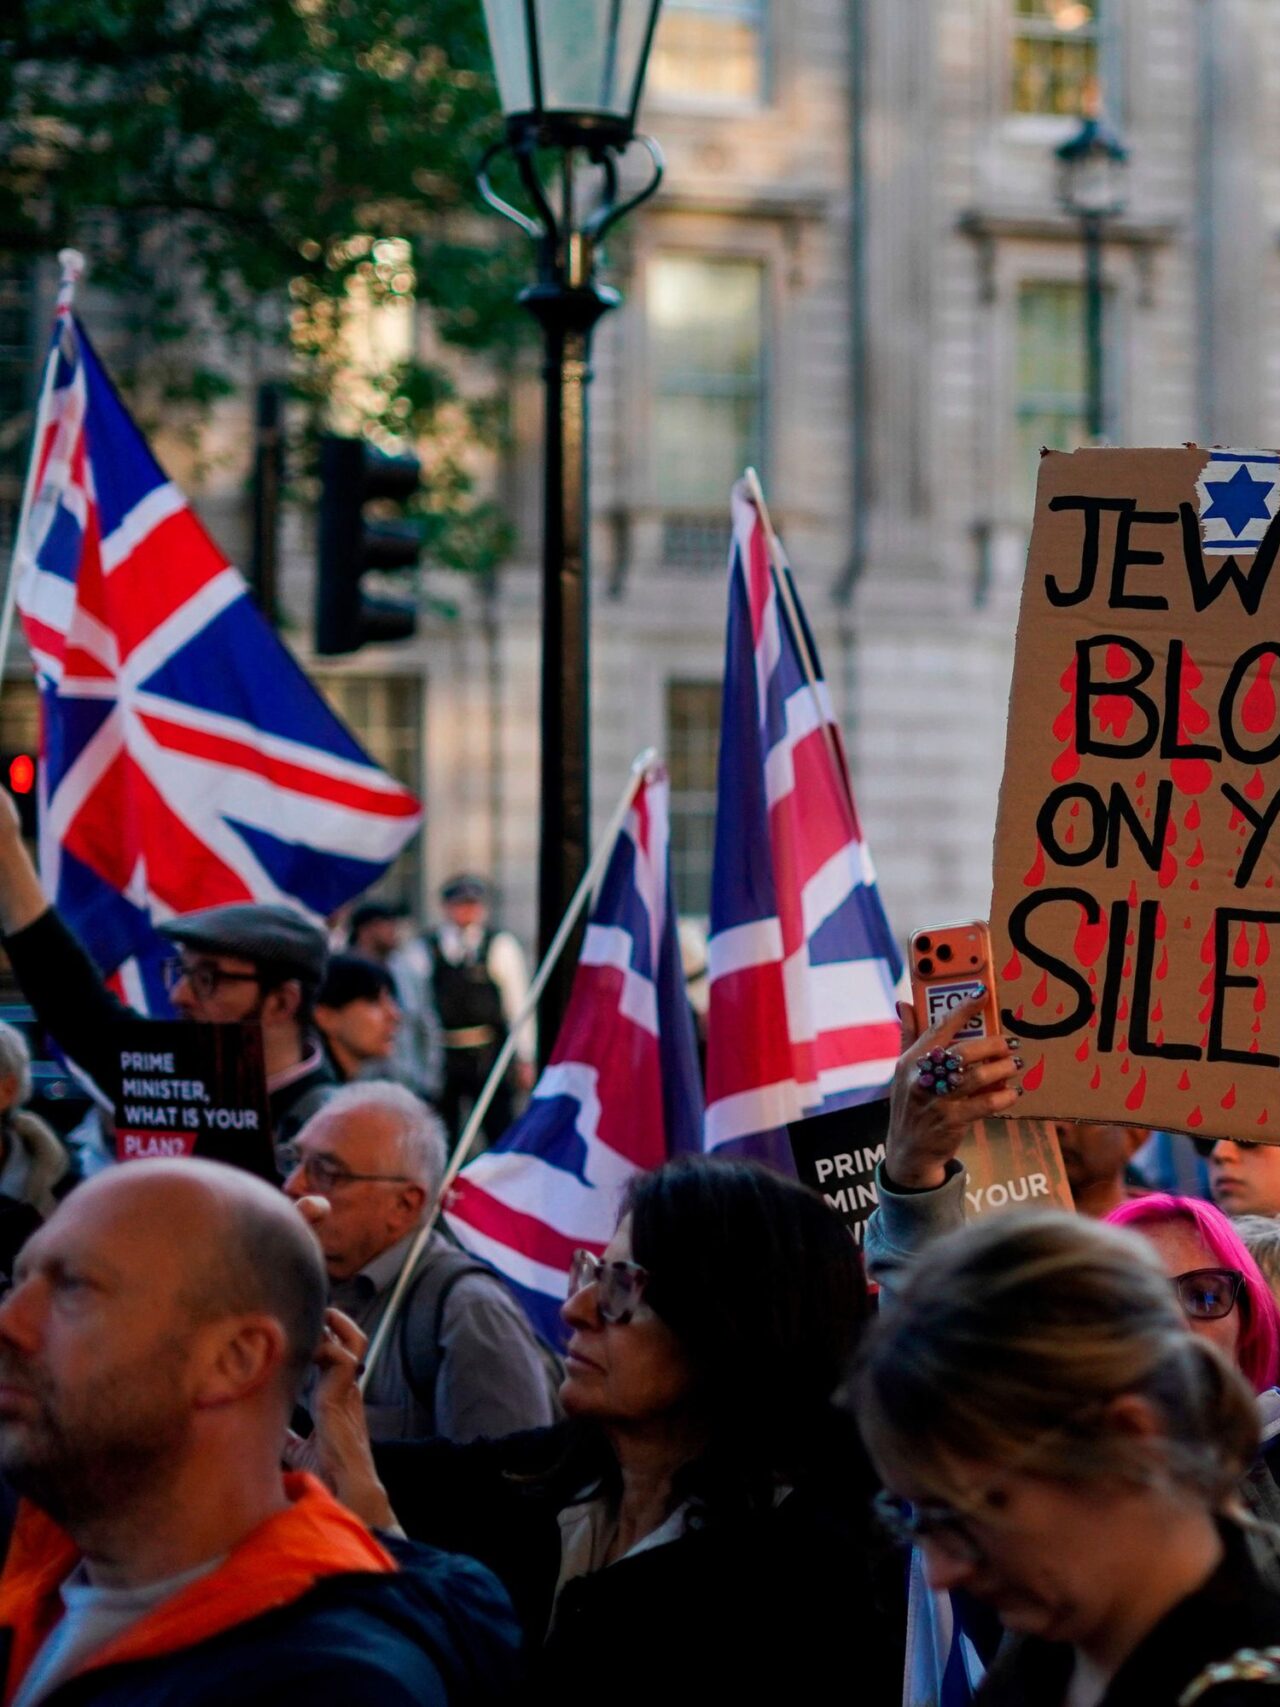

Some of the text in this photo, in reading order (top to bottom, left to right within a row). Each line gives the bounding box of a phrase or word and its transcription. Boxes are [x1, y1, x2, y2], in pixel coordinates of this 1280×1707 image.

[1036, 780, 1173, 871] ON
[120, 1051, 175, 1073] PRIME
[122, 1078, 210, 1104] MINISTER,
[124, 1105, 258, 1130] WHAT IS YOUR
[124, 1135, 185, 1157] PLAN?
[815, 1143, 888, 1184] PRIM
[964, 1172, 1049, 1213] YOUR
